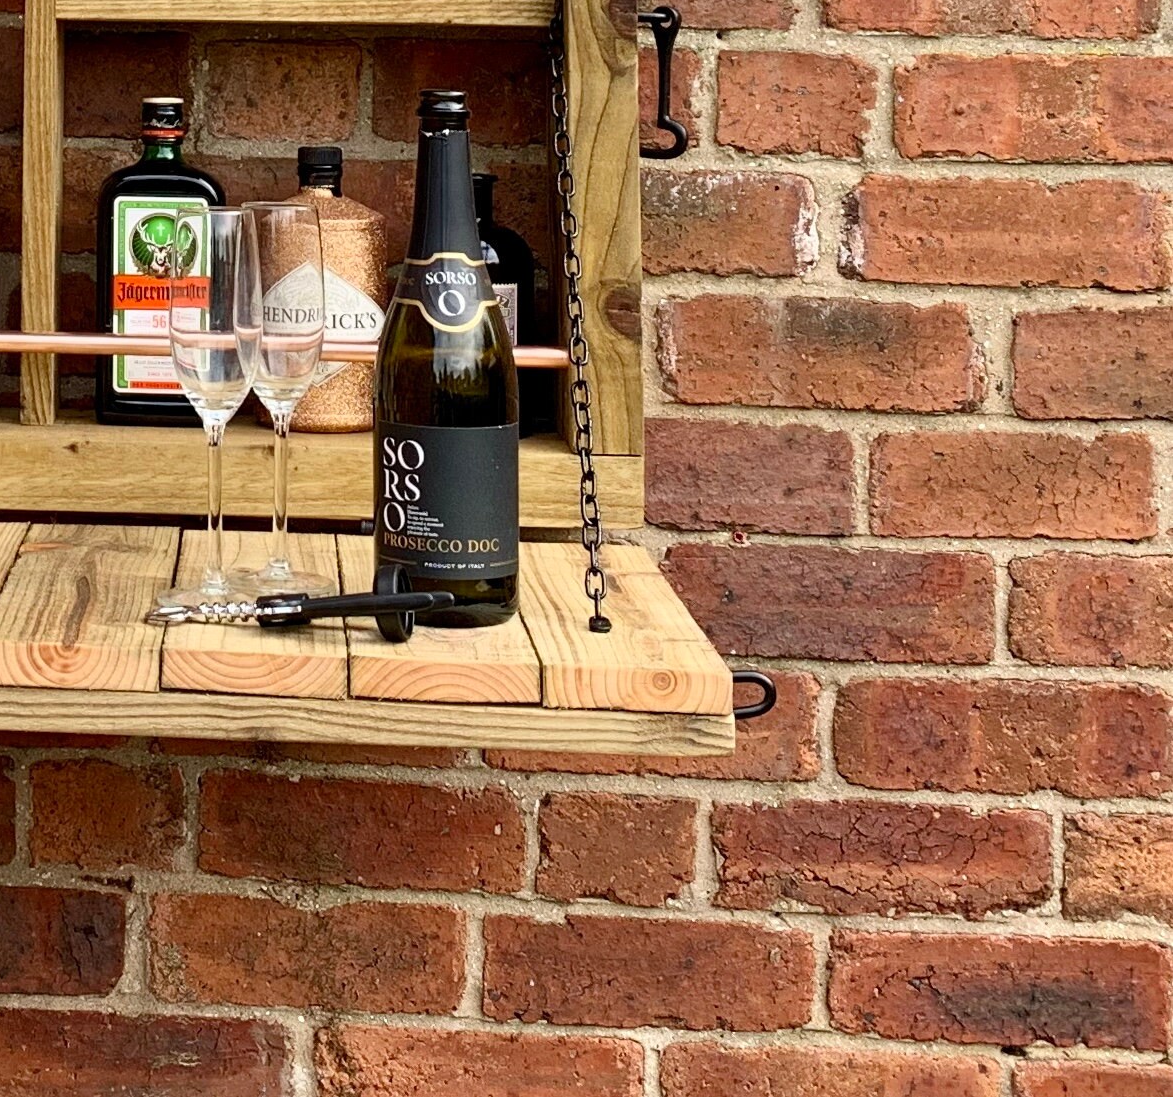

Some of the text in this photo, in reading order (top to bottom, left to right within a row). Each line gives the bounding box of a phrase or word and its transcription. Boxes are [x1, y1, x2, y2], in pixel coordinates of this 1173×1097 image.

[425, 271, 477, 286] SORSO
[437, 289, 466, 317] O
[383, 532, 501, 554] PROSECCO DOC
[424, 561, 486, 570] PRODUCT OF ITALY
